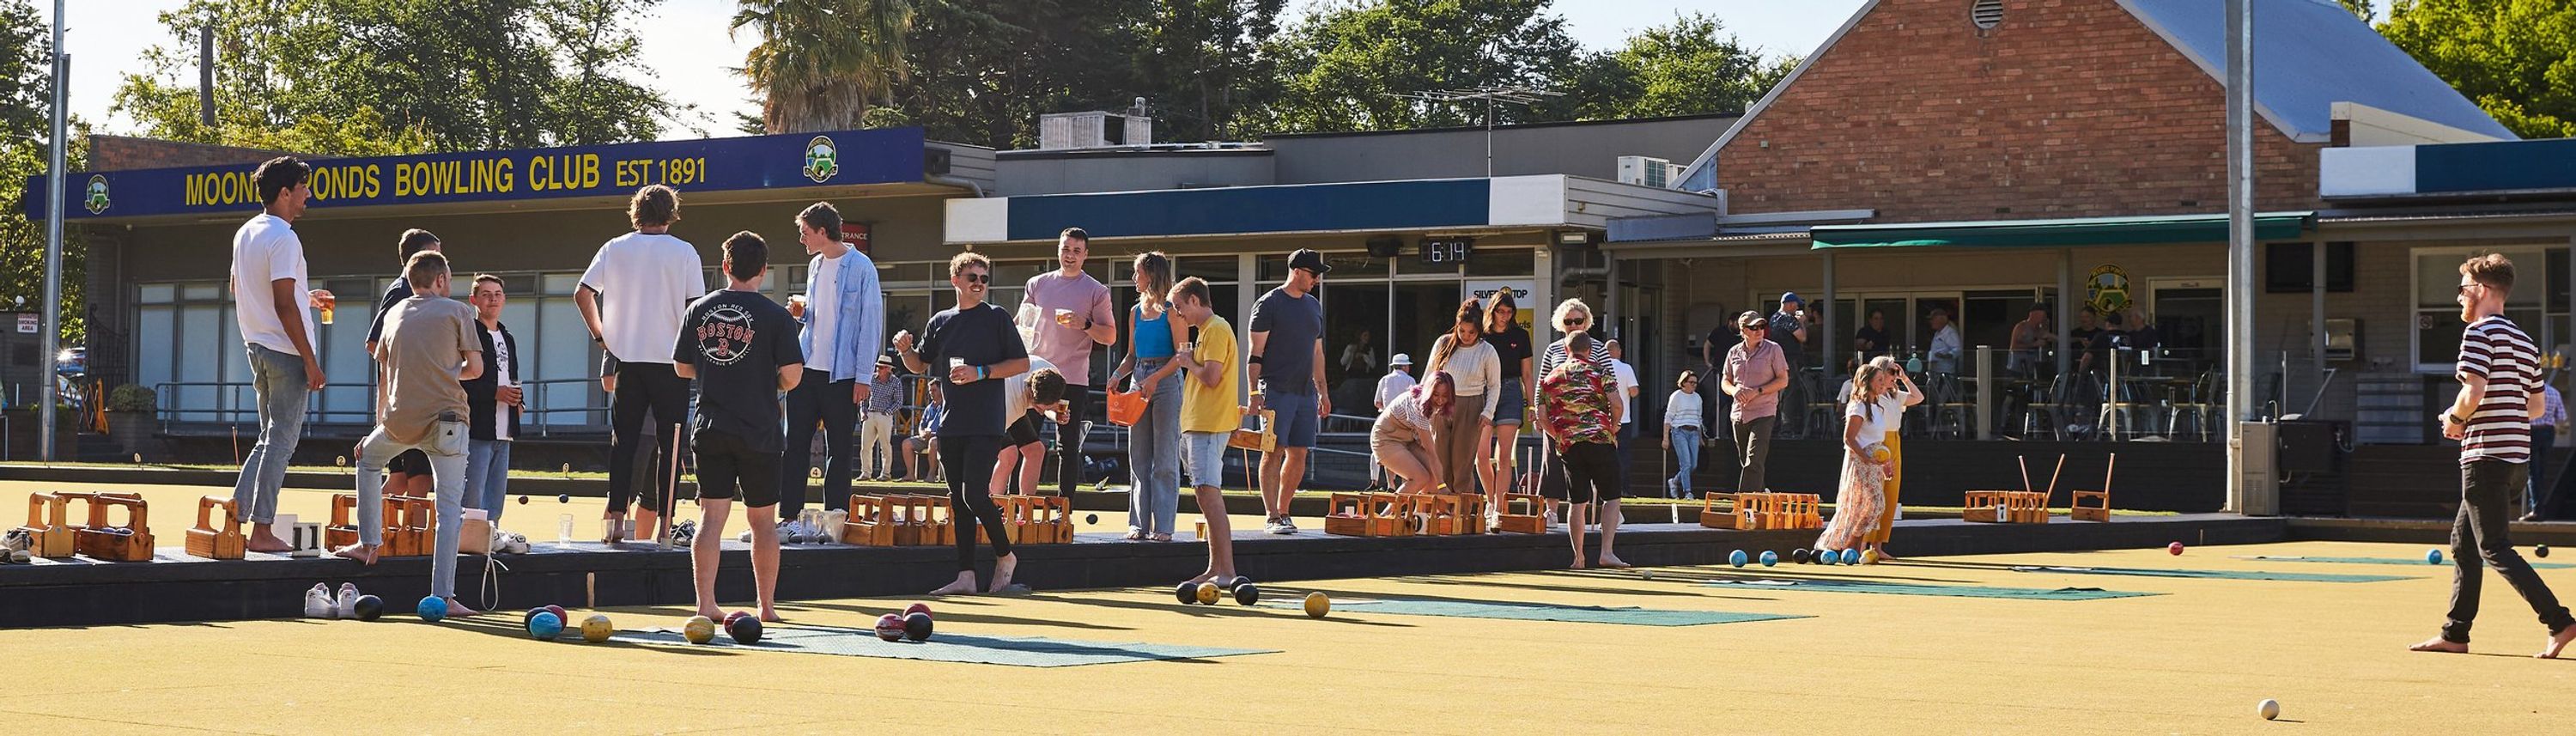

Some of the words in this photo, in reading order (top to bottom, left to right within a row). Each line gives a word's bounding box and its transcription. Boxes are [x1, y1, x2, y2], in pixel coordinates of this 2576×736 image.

[185, 171, 261, 205] MOON
[395, 157, 513, 197] BOWLING
[529, 153, 600, 191] CLUB
[616, 159, 653, 186] EST
[659, 157, 704, 185] 1891
[841, 232, 867, 240] TRANCE
[1431, 242, 1464, 262] 6:14
[1473, 289, 1499, 299] SILVE
[1512, 289, 1528, 299] TOP
[702, 304, 727, 320] BOSTON
[730, 303, 744, 312] RED
[744, 310, 755, 323] SOX
[696, 322, 756, 344] BOSTON
[715, 338, 730, 356] B
[1999, 506, 2005, 520] 7
[293, 526, 319, 551] 11
